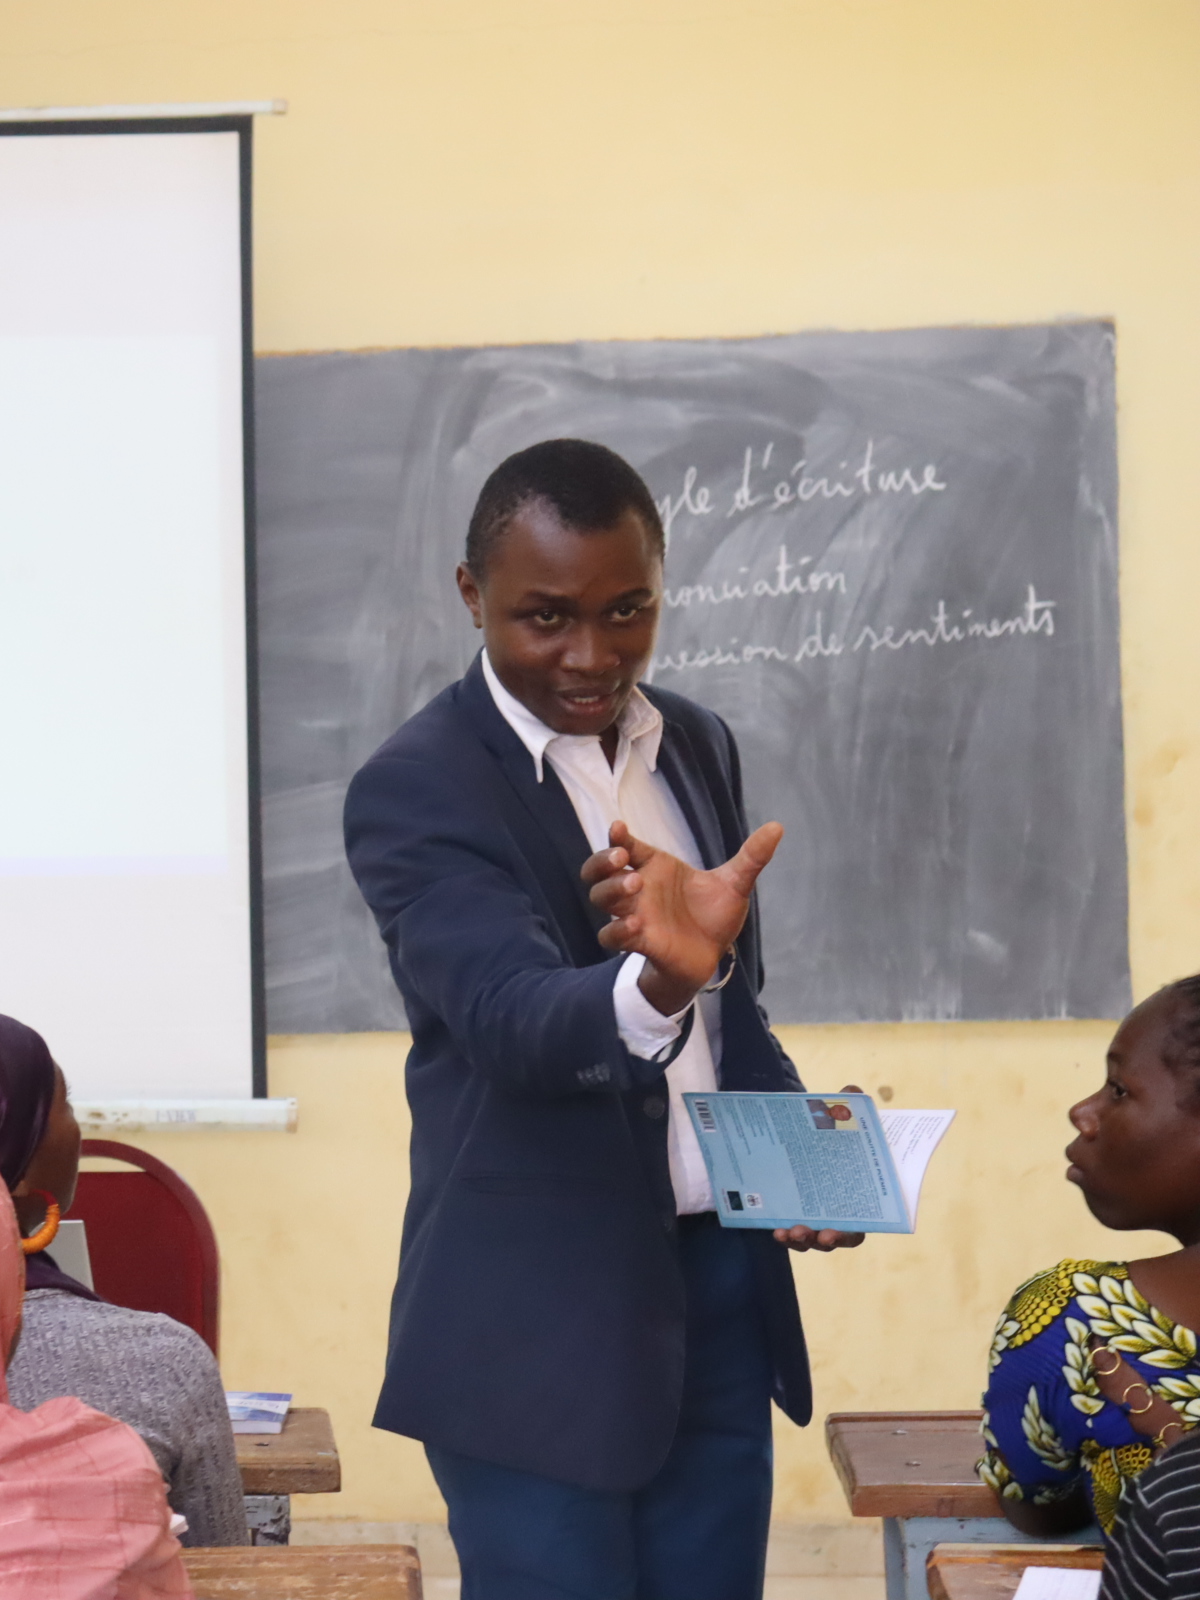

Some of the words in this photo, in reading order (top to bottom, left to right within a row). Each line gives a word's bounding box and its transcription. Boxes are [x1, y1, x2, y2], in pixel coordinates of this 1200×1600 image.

[727, 439, 947, 517] d'écriture
[794, 610, 845, 663] de
[853, 583, 1056, 652] sentiments
